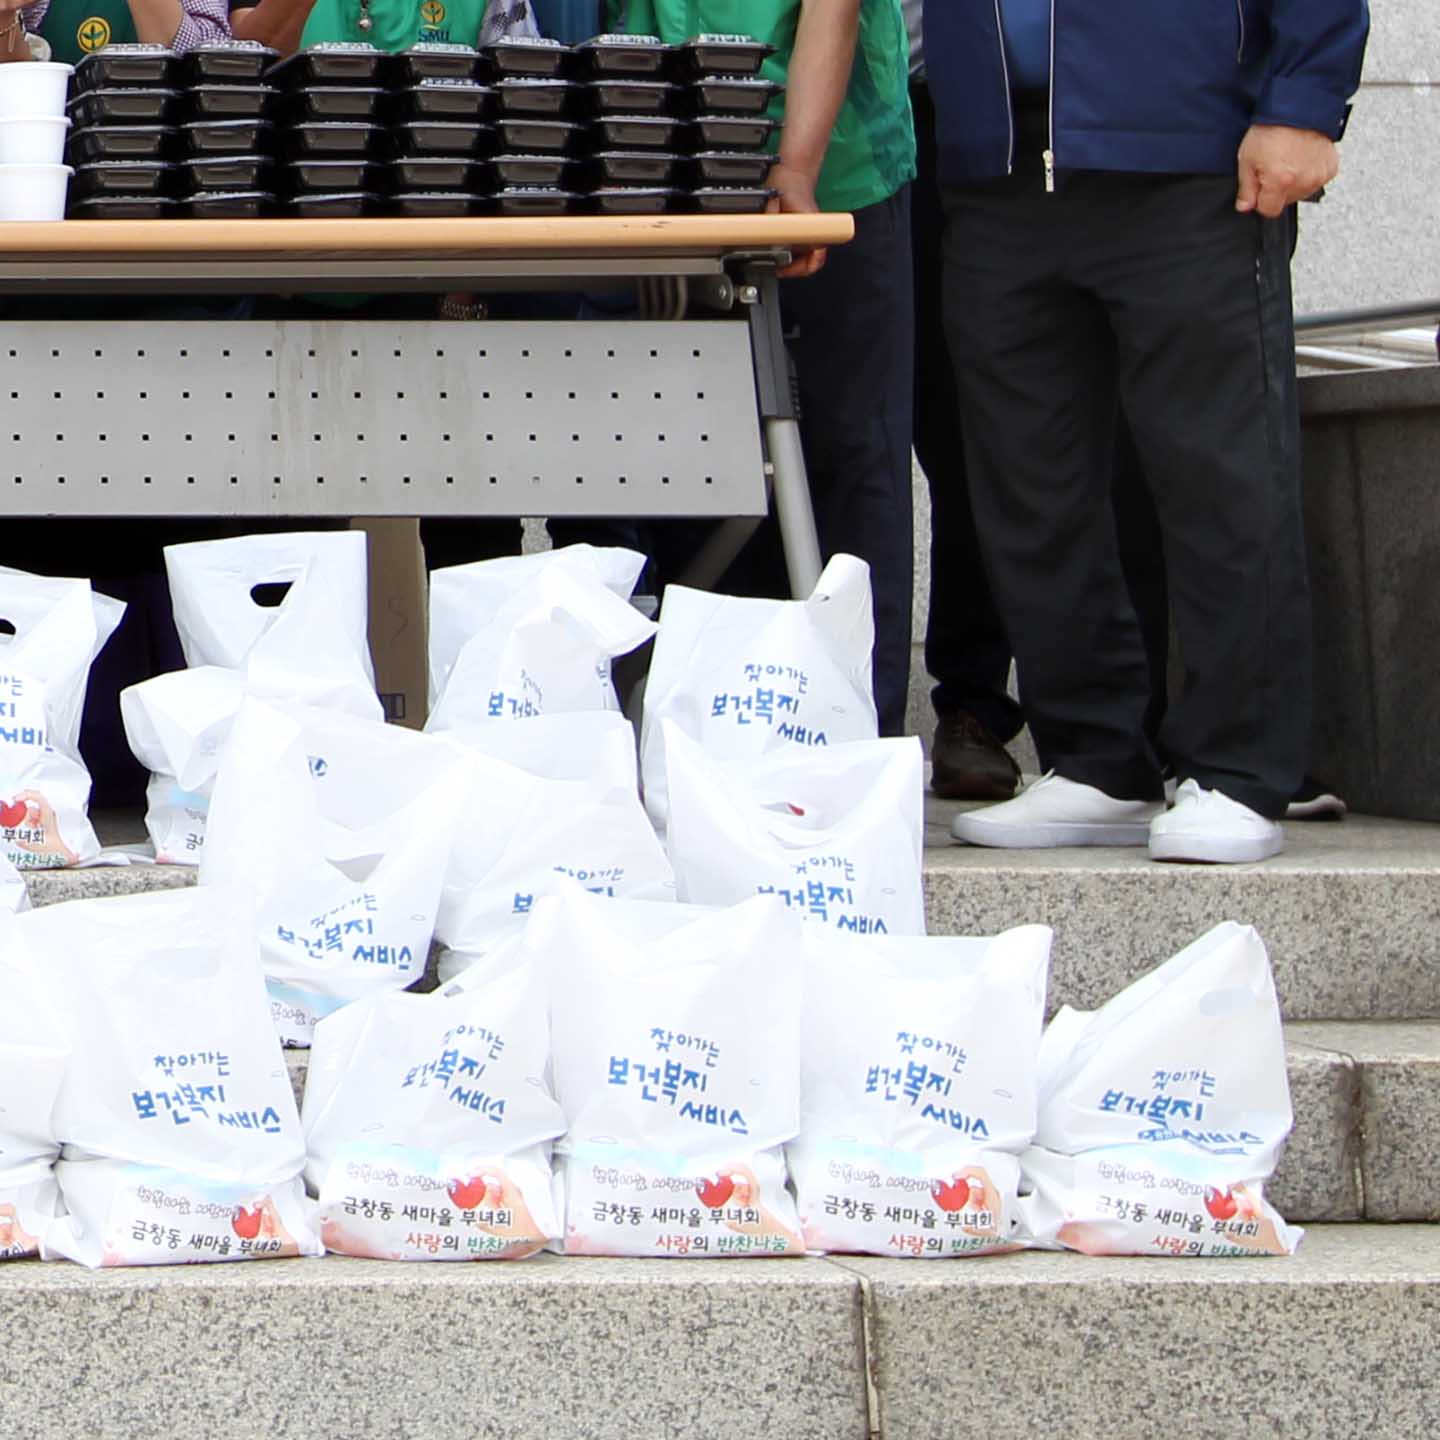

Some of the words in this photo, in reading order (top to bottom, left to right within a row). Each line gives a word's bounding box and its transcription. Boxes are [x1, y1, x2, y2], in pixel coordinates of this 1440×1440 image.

[418, 31, 448, 41] SMU
[744, 663, 808, 694] 찾아가는
[712, 688, 799, 725] 보건복지
[2, 828, 45, 843] 부녀회
[352, 945, 412, 970] 서비스
[649, 1026, 720, 1068] 찾아가는
[896, 1030, 967, 1074] 찾아가는
[154, 1051, 230, 1078] 찾아가는
[401, 1049, 486, 1089] 보건복지
[449, 1085, 506, 1124] 서비스
[608, 1055, 708, 1105] 보건복지
[680, 1101, 749, 1135] 서비스
[1152, 1069, 1216, 1097] 찾아가는
[132, 1082, 225, 1125] 보건복지
[218, 1106, 281, 1133] 서비스
[865, 1060, 952, 1106] 보건복지
[921, 1103, 990, 1141] 서비스
[341, 1196, 395, 1222] 금창동
[402, 1205, 455, 1227] 새마을
[459, 1209, 512, 1227] 부녀회
[592, 1201, 644, 1225] 금창동
[651, 1207, 703, 1228] 새마을
[709, 1208, 760, 1226] 부녀회
[823, 1194, 877, 1222] 금창동
[884, 1206, 938, 1229] 새마을
[944, 1211, 992, 1229] 부녀회
[1097, 1194, 1148, 1223] 금창동
[1154, 1208, 1205, 1234] 새마을
[1211, 1220, 1259, 1237] 부녀회
[131, 1220, 182, 1249] 금창동
[188, 1234, 233, 1255] 새마을
[238, 1240, 282, 1254] 부녀회
[405, 1232, 459, 1254] 사랑의
[655, 1234, 710, 1254] 사랑의
[716, 1235, 788, 1253] 반찬나눔
[888, 1233, 944, 1255] 사랑의
[1152, 1234, 1204, 1256] 사랑의
